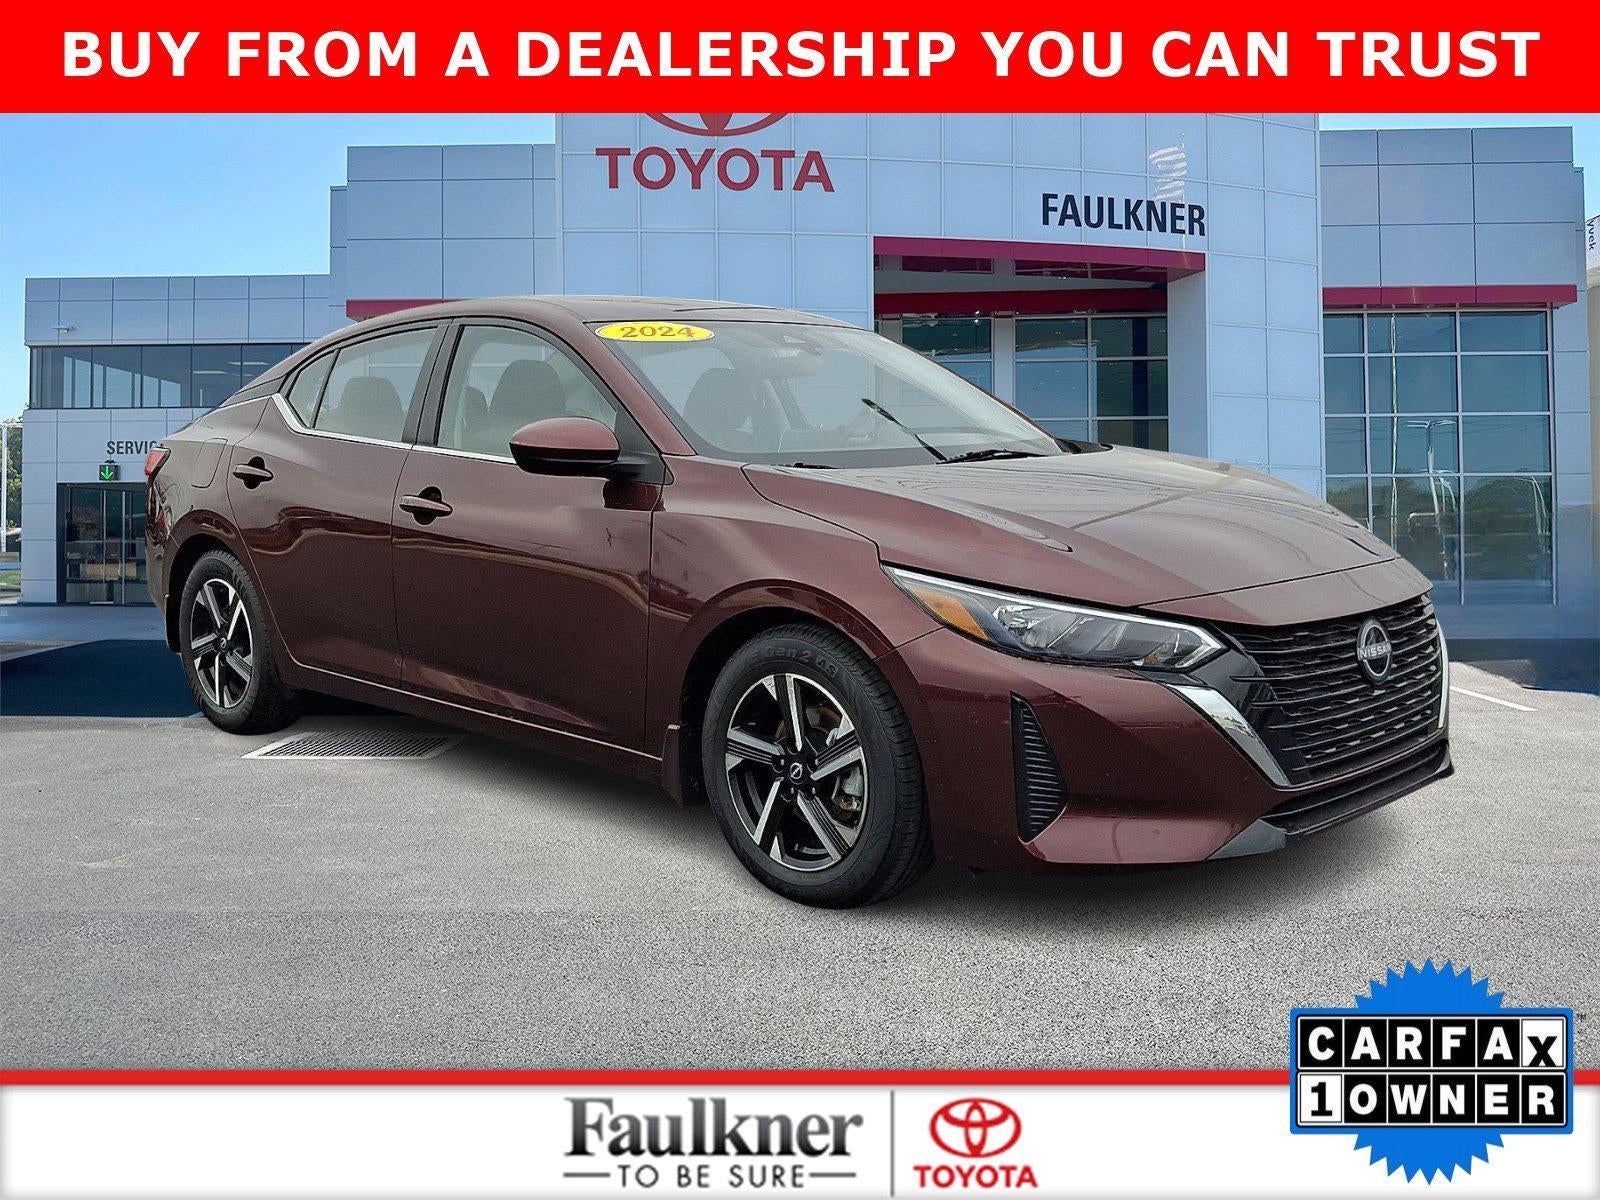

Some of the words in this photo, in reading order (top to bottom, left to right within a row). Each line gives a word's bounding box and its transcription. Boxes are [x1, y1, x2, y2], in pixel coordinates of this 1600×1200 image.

[595, 146, 835, 193] TOYOTA
[1041, 193, 1206, 237] FAULKNER
[620, 326, 695, 338] 2024
[1359, 642, 1391, 660] NISSAN
